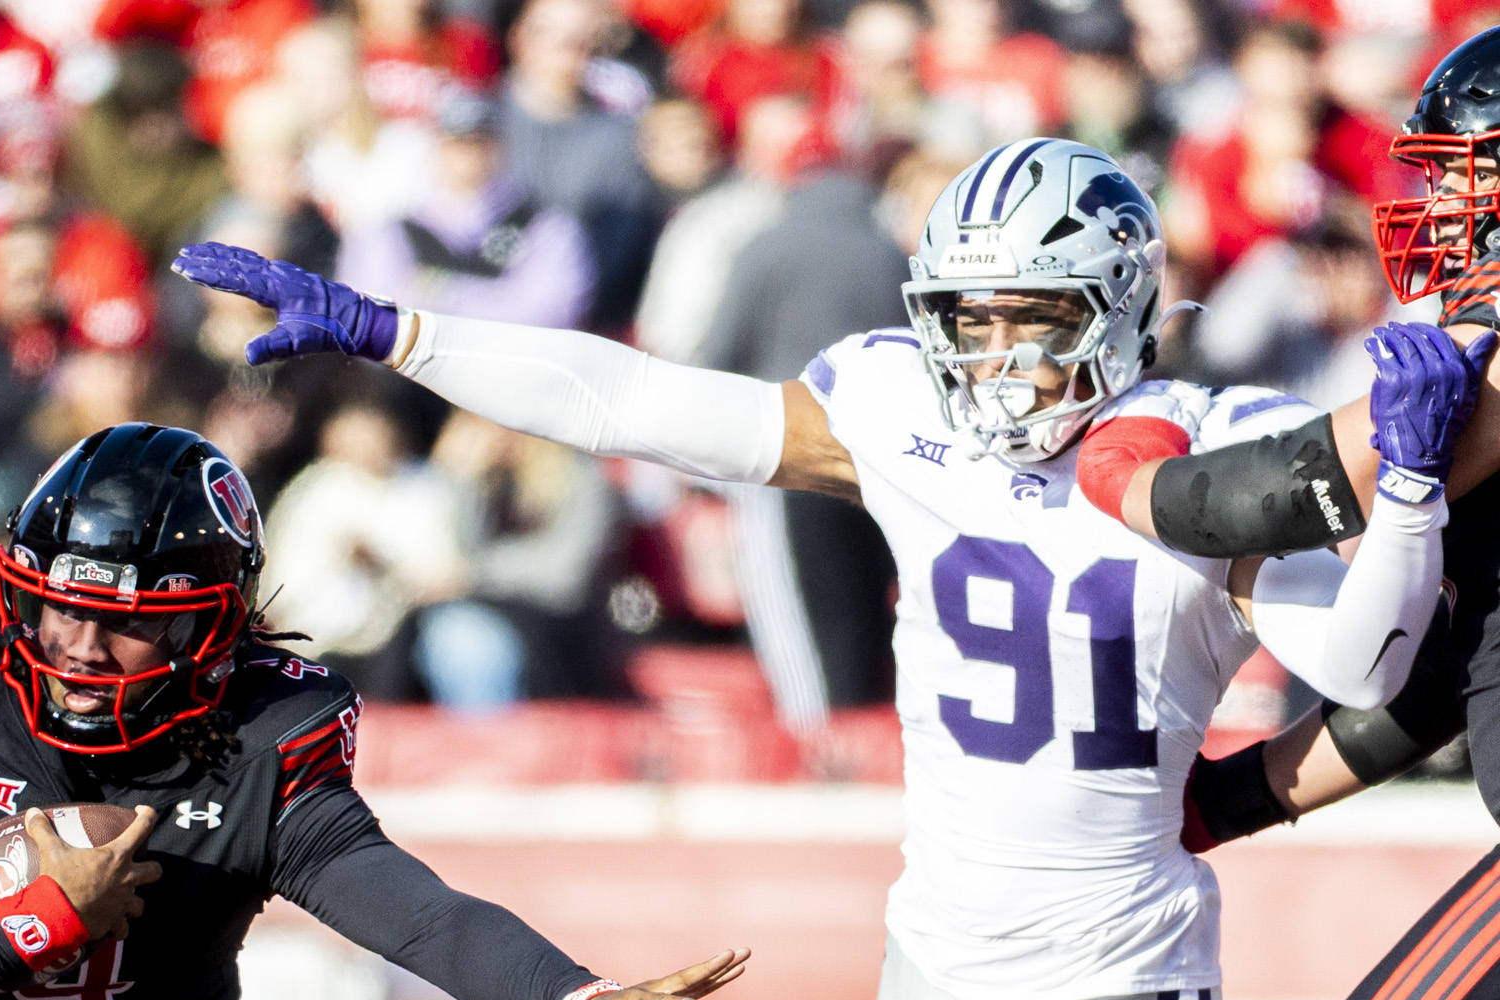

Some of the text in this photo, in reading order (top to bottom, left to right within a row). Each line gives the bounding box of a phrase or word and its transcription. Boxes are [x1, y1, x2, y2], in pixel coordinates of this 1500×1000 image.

[948, 254, 999, 264] K-STATE
[1025, 263, 1065, 273] OAKLEY
[902, 433, 953, 467] XII
[209, 469, 252, 537] U
[1310, 478, 1345, 532] Mueller
[932, 533, 1159, 771] 91
[21, 924, 45, 947] U
